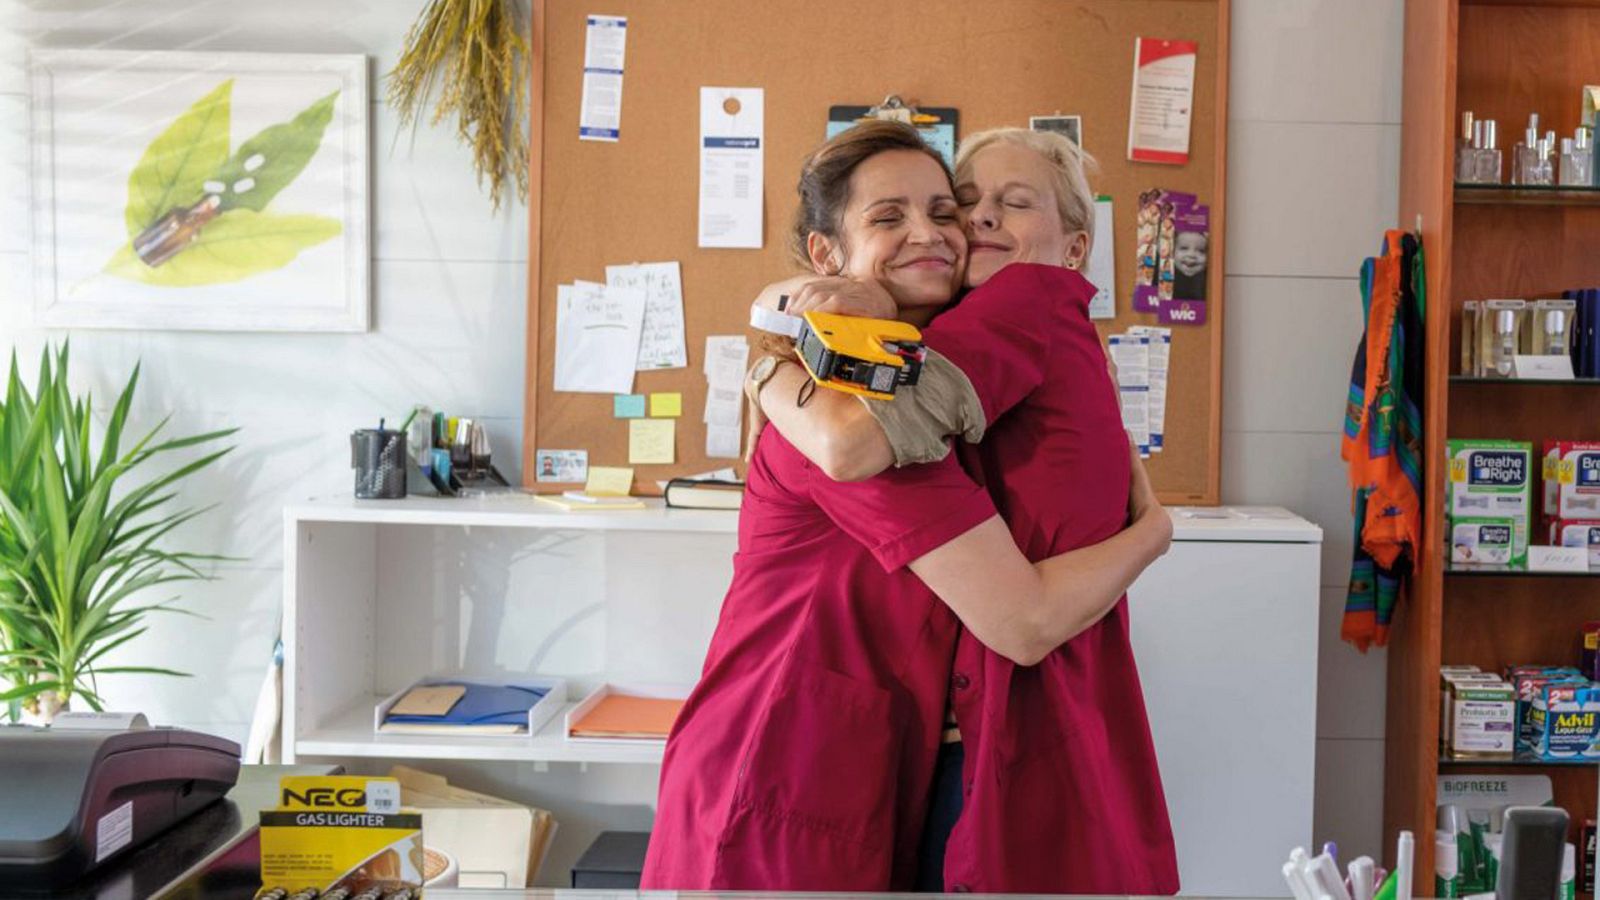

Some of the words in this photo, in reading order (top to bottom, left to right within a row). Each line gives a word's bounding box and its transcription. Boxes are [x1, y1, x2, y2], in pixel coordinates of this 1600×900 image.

[1474, 454, 1522, 468] Breathe
[1490, 468, 1522, 482] Right
[1548, 690, 1561, 703] 2
[1460, 707, 1496, 716] Probiotic
[1555, 713, 1594, 727] Advil
[283, 788, 366, 807] NEO
[296, 813, 326, 826] GAS
[327, 813, 385, 827] LIGHTER
